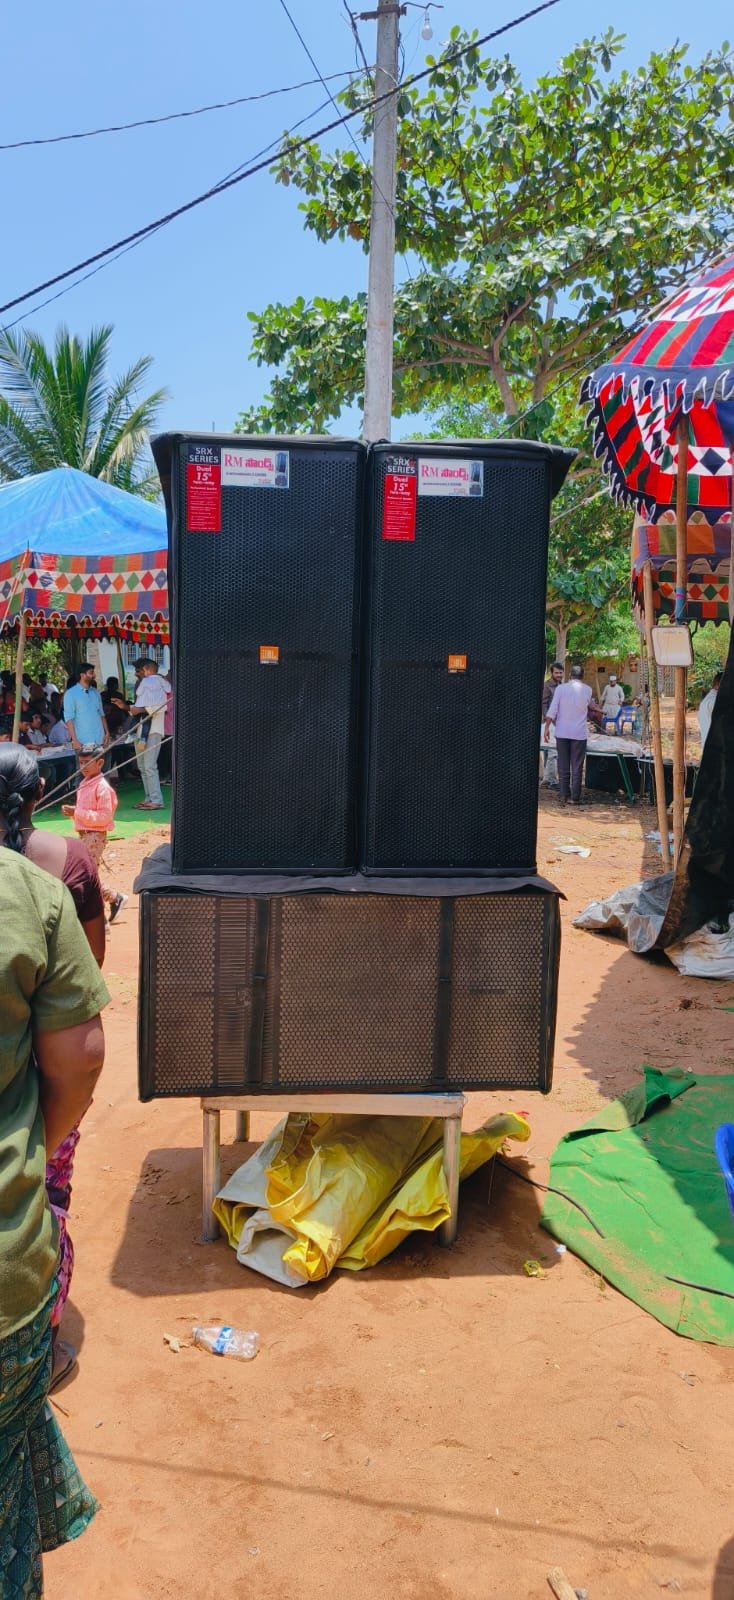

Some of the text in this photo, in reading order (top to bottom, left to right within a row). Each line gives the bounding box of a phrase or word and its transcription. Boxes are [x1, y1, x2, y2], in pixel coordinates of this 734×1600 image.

[195, 447, 213, 455] SRX
[189, 454, 219, 464] SERIES
[224, 453, 243, 468] RM
[393, 458, 410, 467] SRX
[196, 465, 212, 473] Dual
[387, 465, 416, 474] SERIES
[421, 464, 439, 478] RM
[393, 476, 409, 484] Dual
